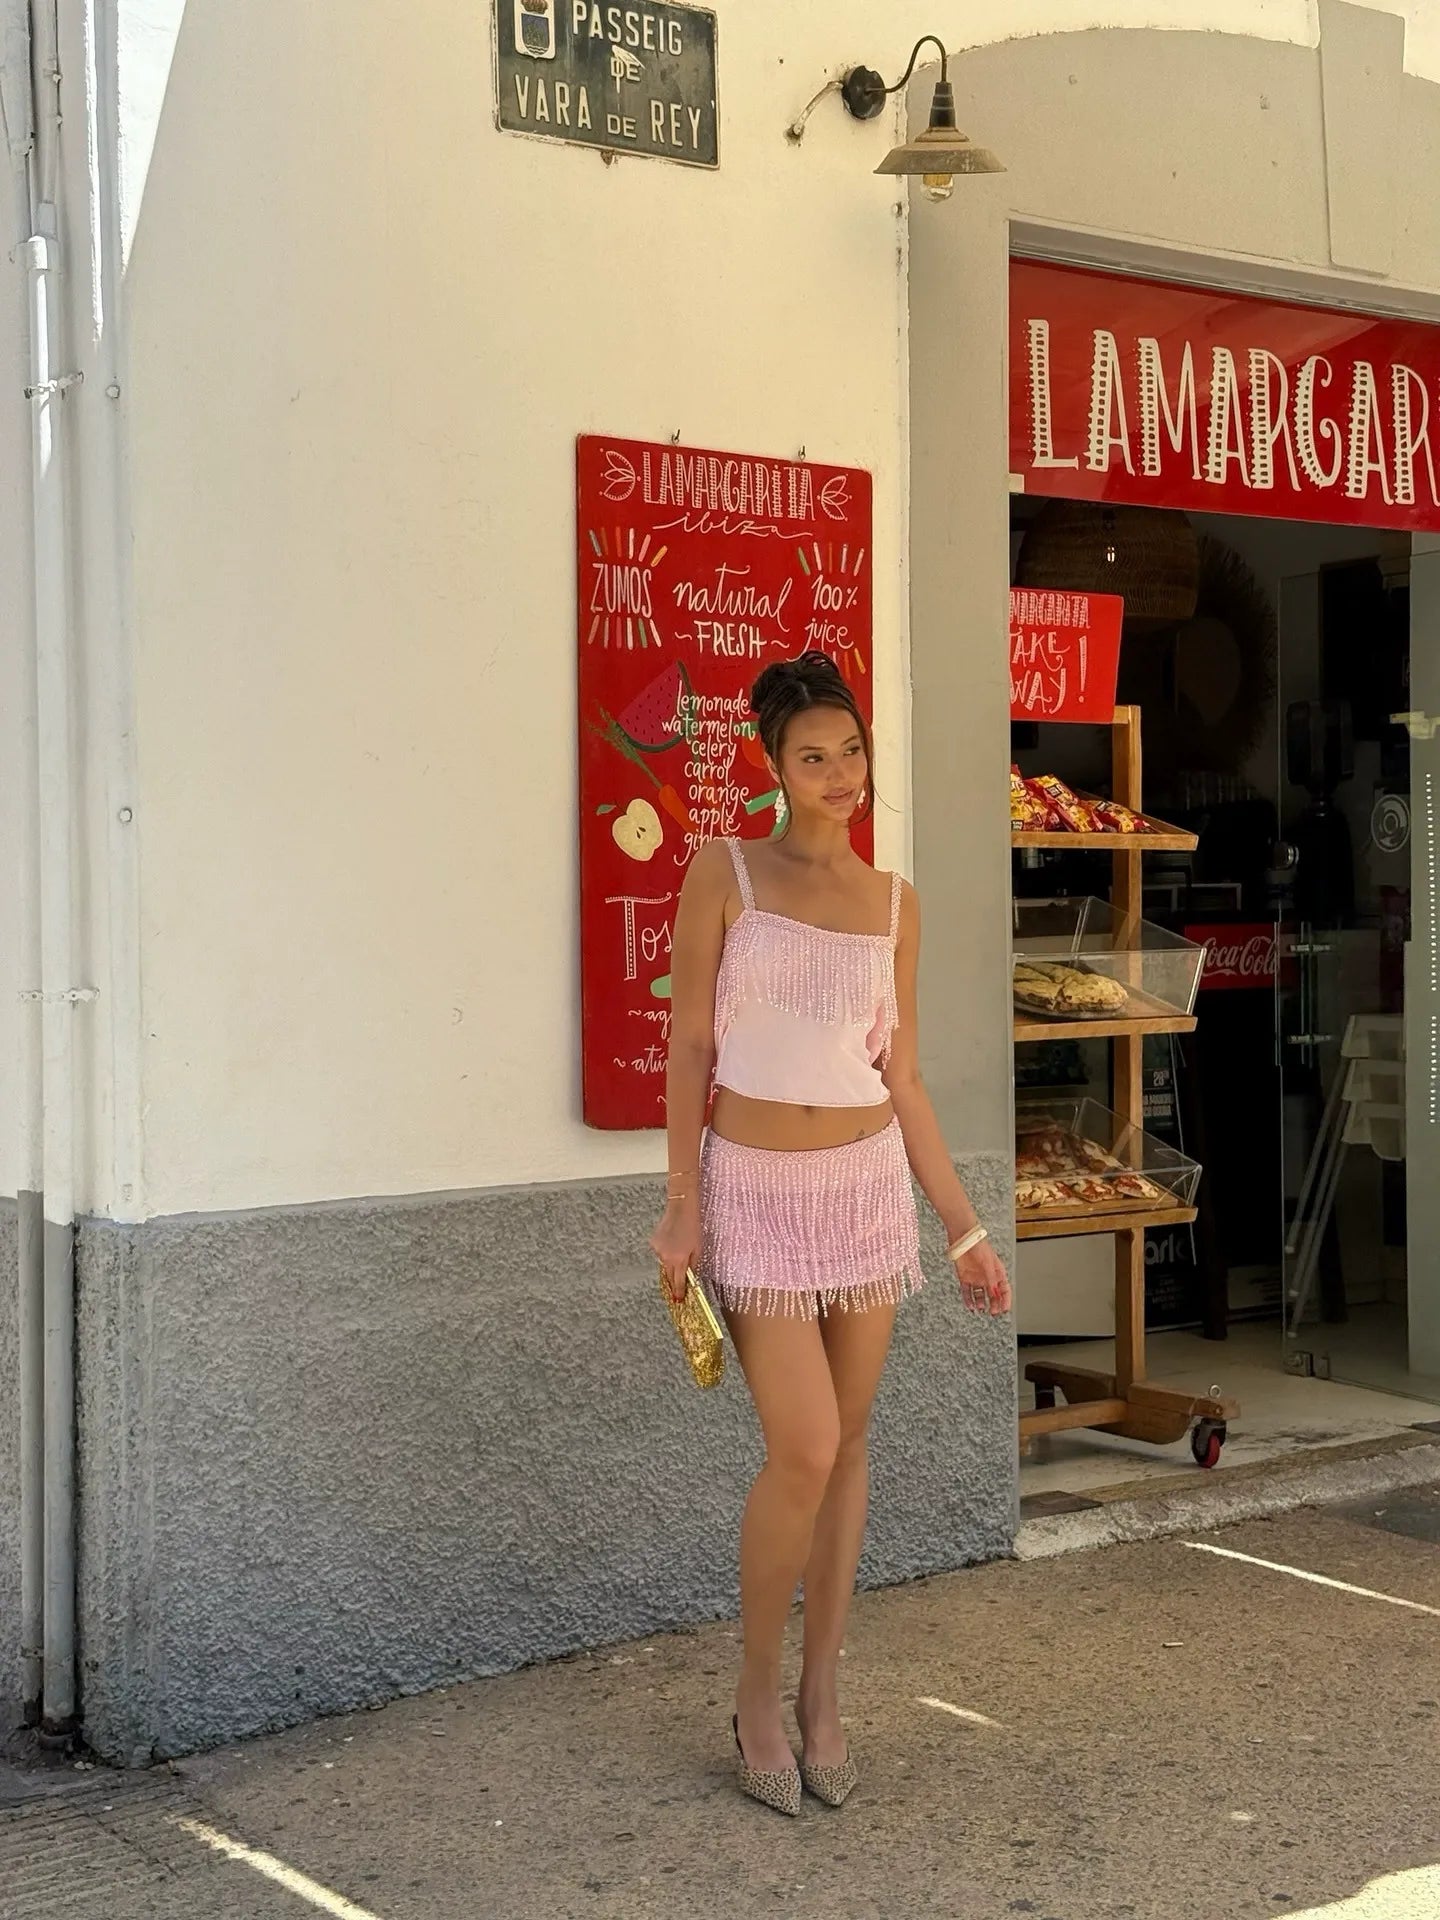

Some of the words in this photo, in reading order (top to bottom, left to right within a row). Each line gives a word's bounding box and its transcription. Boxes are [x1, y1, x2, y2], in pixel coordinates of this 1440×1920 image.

[573, 1, 682, 56] PASSEIG
[610, 56, 641, 82] DE
[515, 74, 592, 130] VARA
[606, 114, 637, 139] DE
[651, 100, 701, 150] REY
[590, 562, 653, 619] ZUMOS
[672, 562, 793, 633] natural
[811, 574, 858, 611] 100%
[694, 620, 768, 660] FRESH
[786, 617, 855, 662] juice
[676, 680, 750, 719] lemonade
[661, 714, 756, 745] watermelon
[691, 736, 737, 767] celery
[684, 757, 735, 788] carrot
[688, 785, 752, 818] orange
[688, 806, 741, 842] apple
